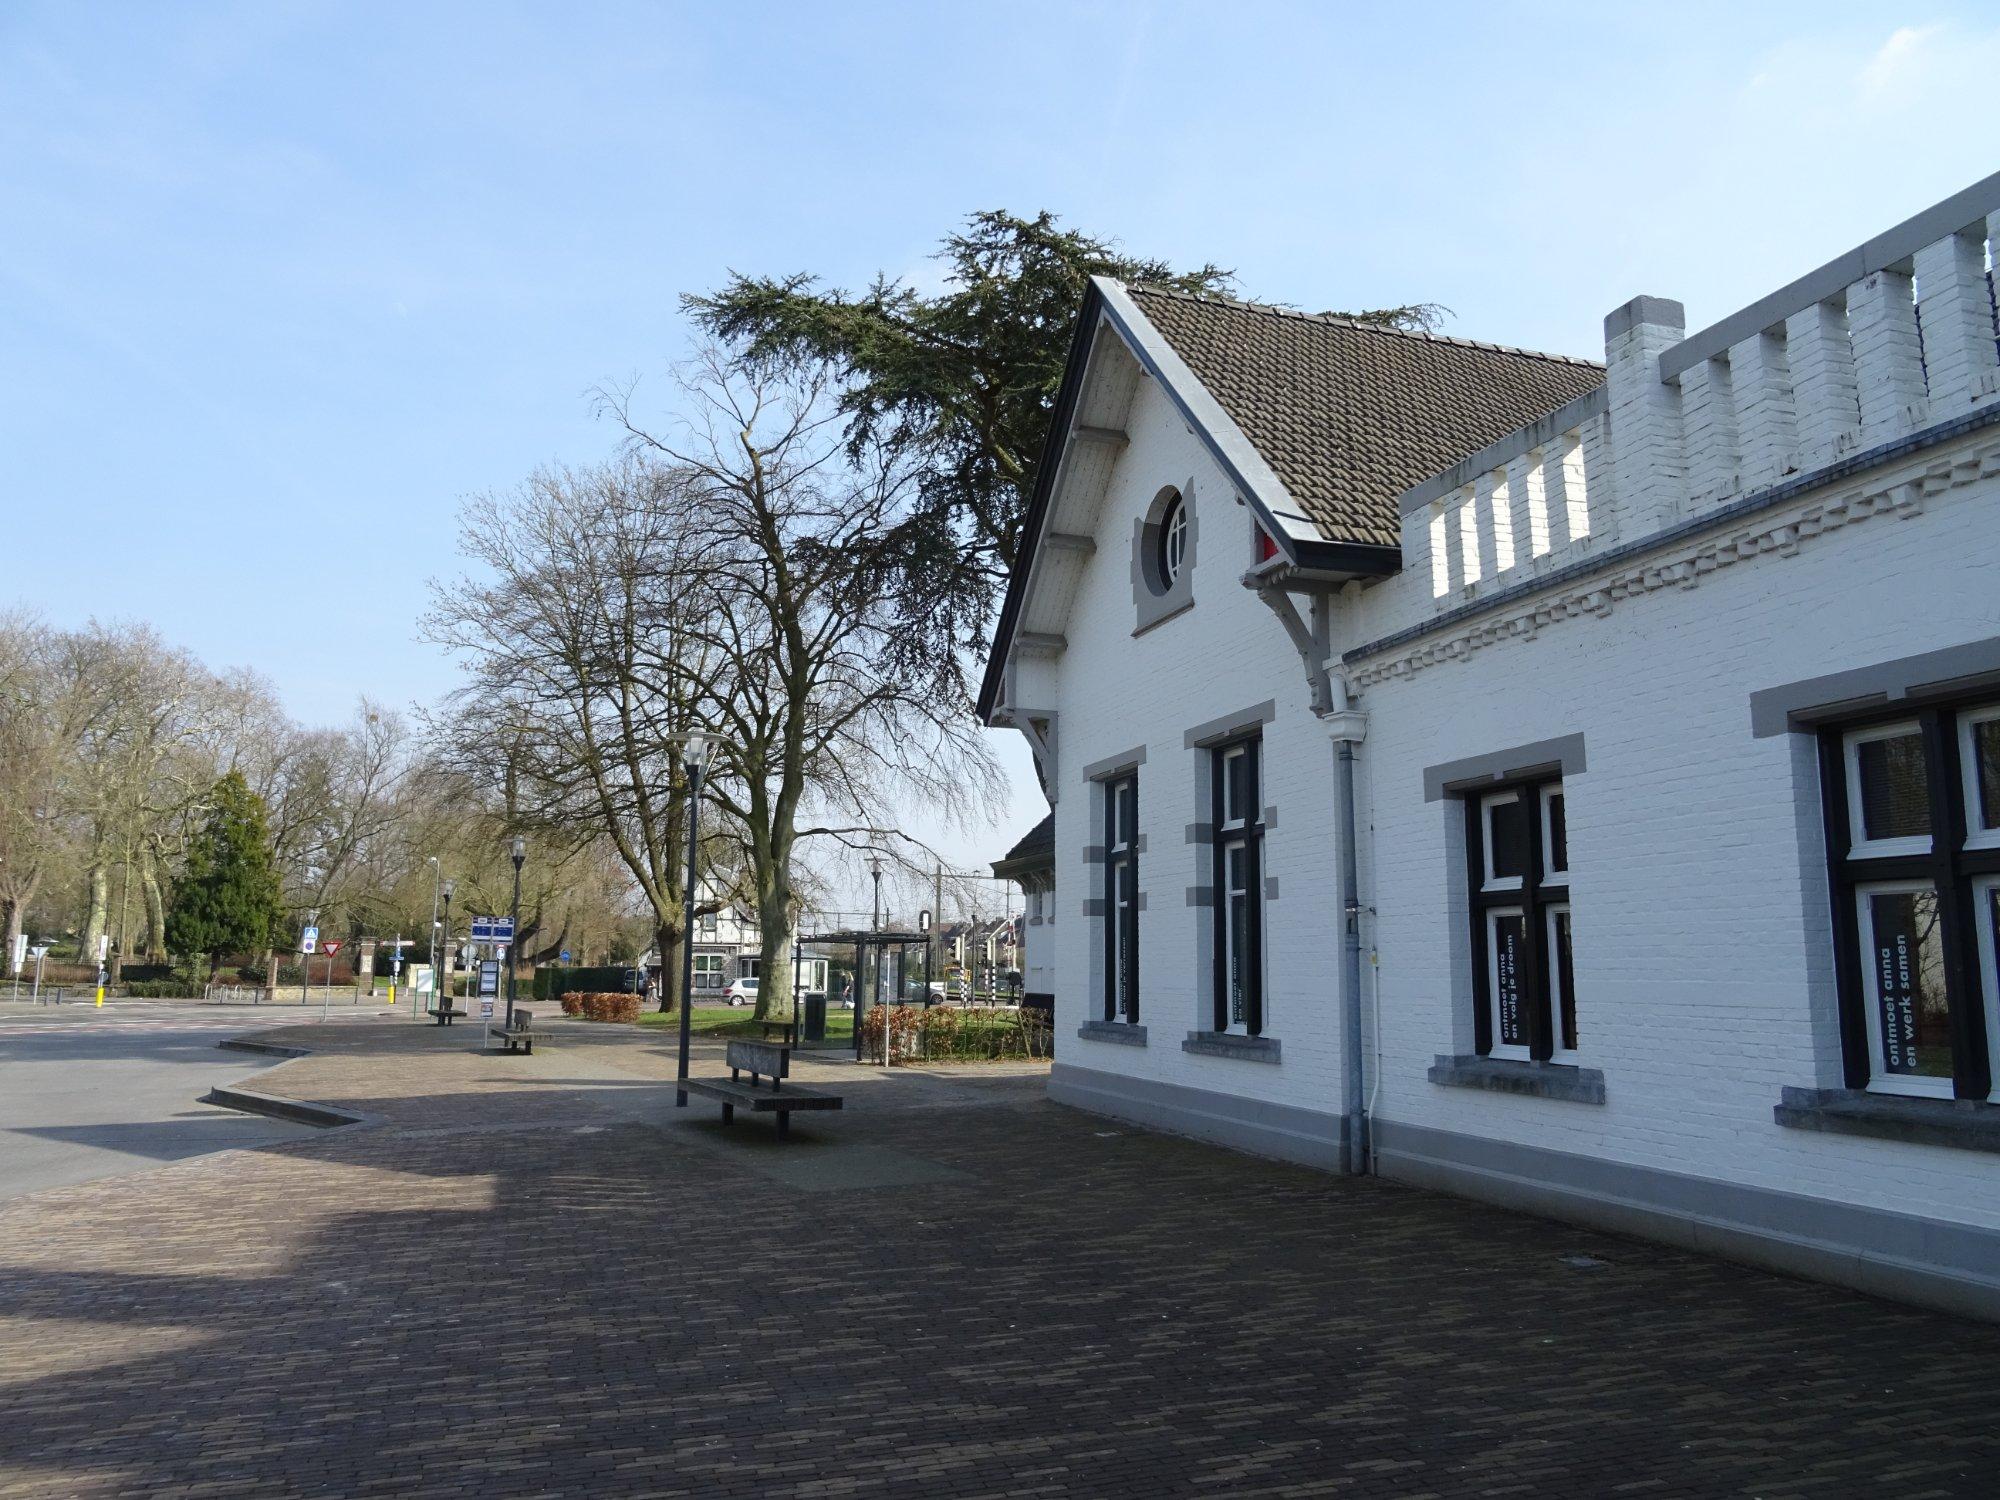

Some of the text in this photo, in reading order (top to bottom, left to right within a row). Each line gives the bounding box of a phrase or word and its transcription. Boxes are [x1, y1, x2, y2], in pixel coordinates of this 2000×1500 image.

[1508, 979, 1516, 989] je
[1508, 994, 1517, 1019] volg
[1882, 948, 1899, 1066] ontmoet anna
[1897, 935, 1916, 1067] en werk samen
[1511, 1025, 1517, 1039] en
